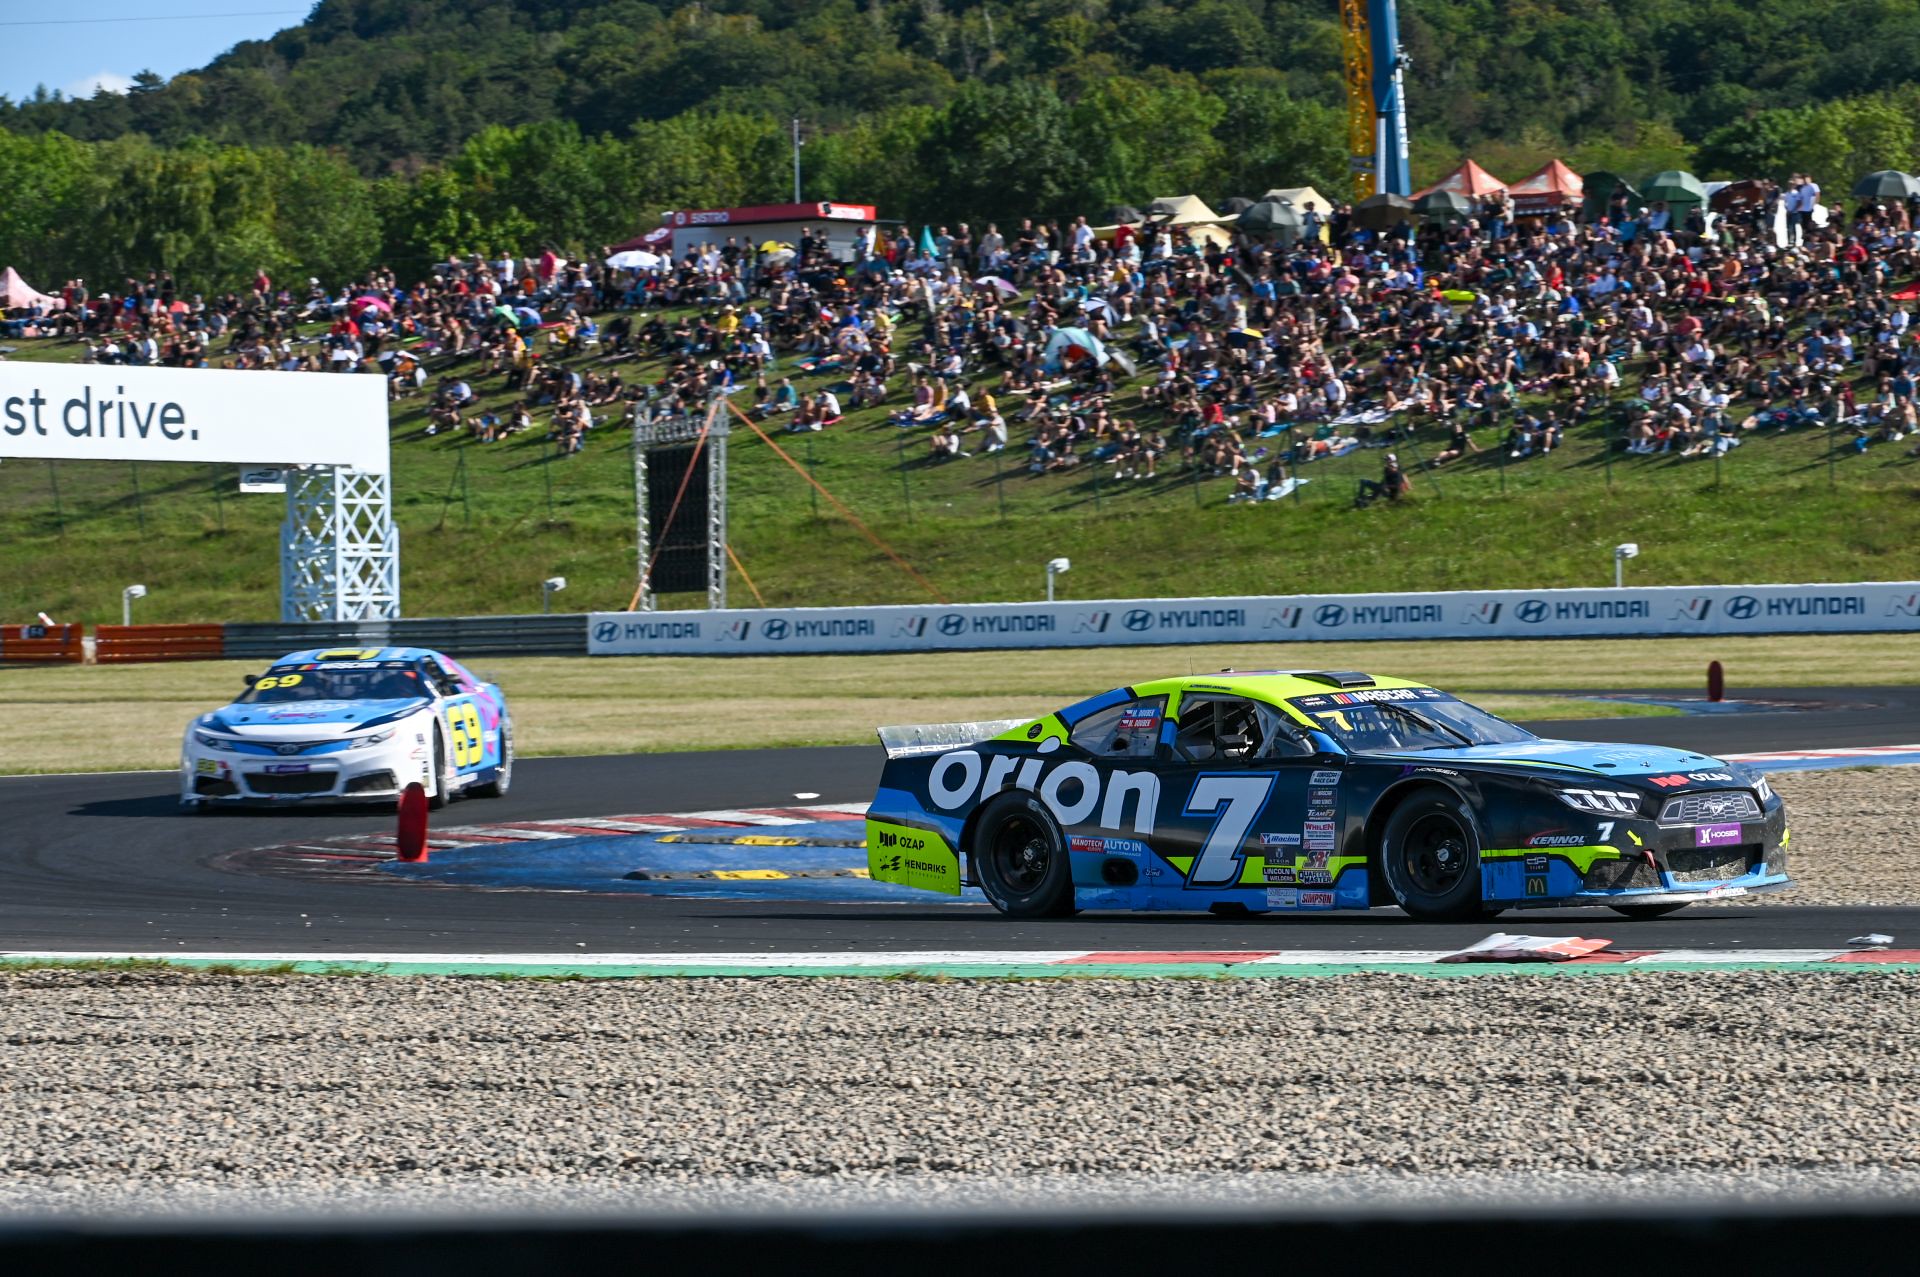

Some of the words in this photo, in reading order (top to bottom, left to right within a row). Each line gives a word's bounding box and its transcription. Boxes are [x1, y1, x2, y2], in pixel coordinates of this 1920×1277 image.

[3, 388, 47, 436] st
[63, 385, 199, 441] drive.
[625, 623, 701, 639] HYUNDAI
[795, 619, 875, 637] HYUNDAI
[972, 614, 1056, 633] HYUNDAI
[1160, 609, 1246, 629] HYUNDAI
[1353, 604, 1443, 625] HYUNDAI
[1556, 600, 1650, 620] HYUNDAI
[1767, 597, 1865, 619] HYUNDAI
[254, 674, 303, 690] 69
[1353, 688, 1420, 702] NASCAR
[1315, 710, 1354, 731] 7
[447, 701, 483, 768] 69
[1414, 767, 1459, 777] HOOSIER
[1688, 772, 1733, 782] OZAP
[929, 736, 1161, 835] orion
[1184, 773, 1277, 887] 7
[1596, 822, 1615, 842] 7
[1711, 829, 1738, 839] HOOSIER
[900, 836, 925, 850] OZAP
[1071, 838, 1103, 848] NANOTECH
[1104, 839, 1131, 851] AUTO
[1132, 841, 1142, 852] IN
[1529, 835, 1585, 845] KENNOL
[904, 859, 947, 874] HENDRIKS
[1301, 893, 1332, 904] SIMPSON
